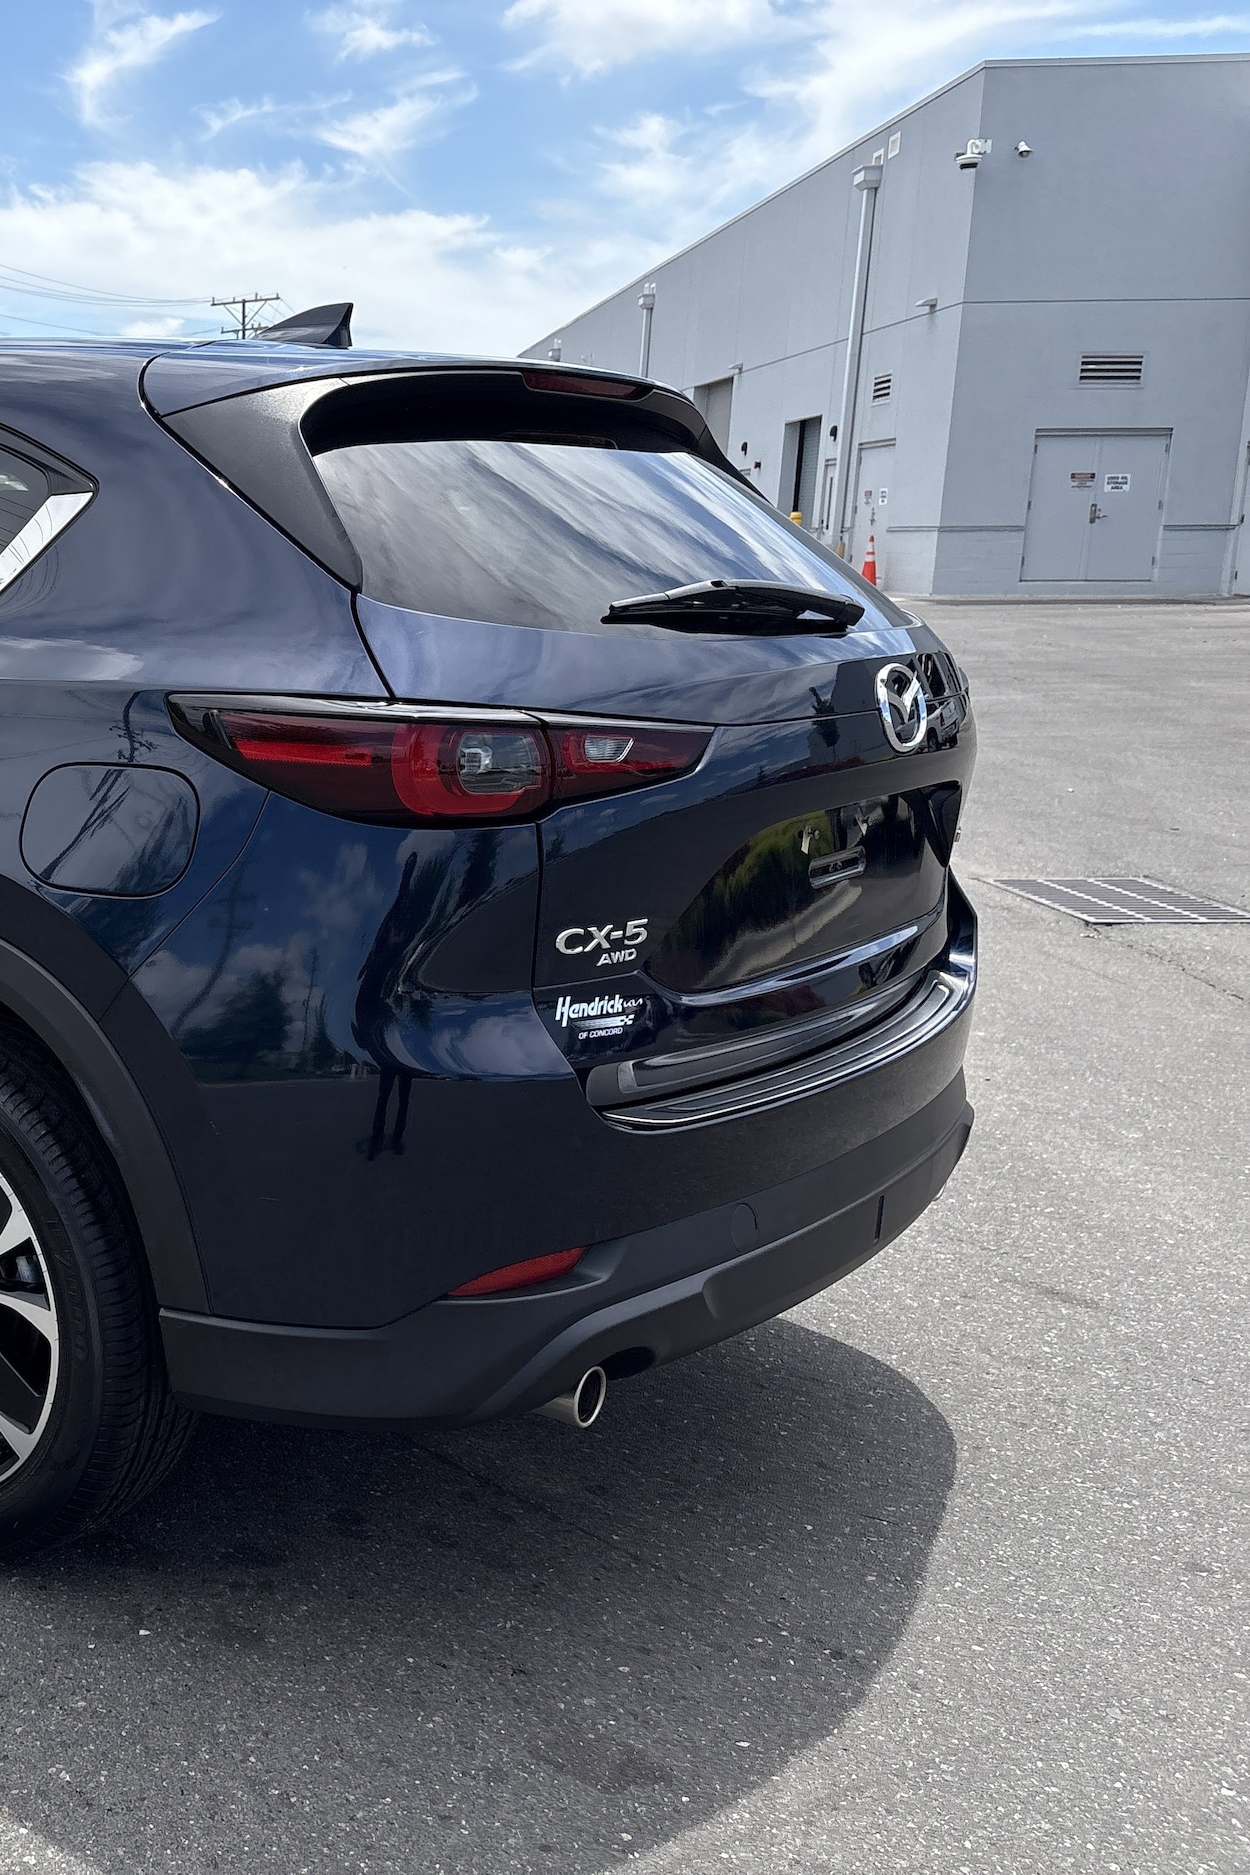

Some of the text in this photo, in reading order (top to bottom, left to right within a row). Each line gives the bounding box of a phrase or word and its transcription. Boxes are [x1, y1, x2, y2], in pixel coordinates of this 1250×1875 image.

[555, 918, 648, 955] CX-5
[596, 948, 637, 967] AWD
[555, 994, 623, 1028] Hendrick
[578, 1027, 624, 1040] OF CONCORD
